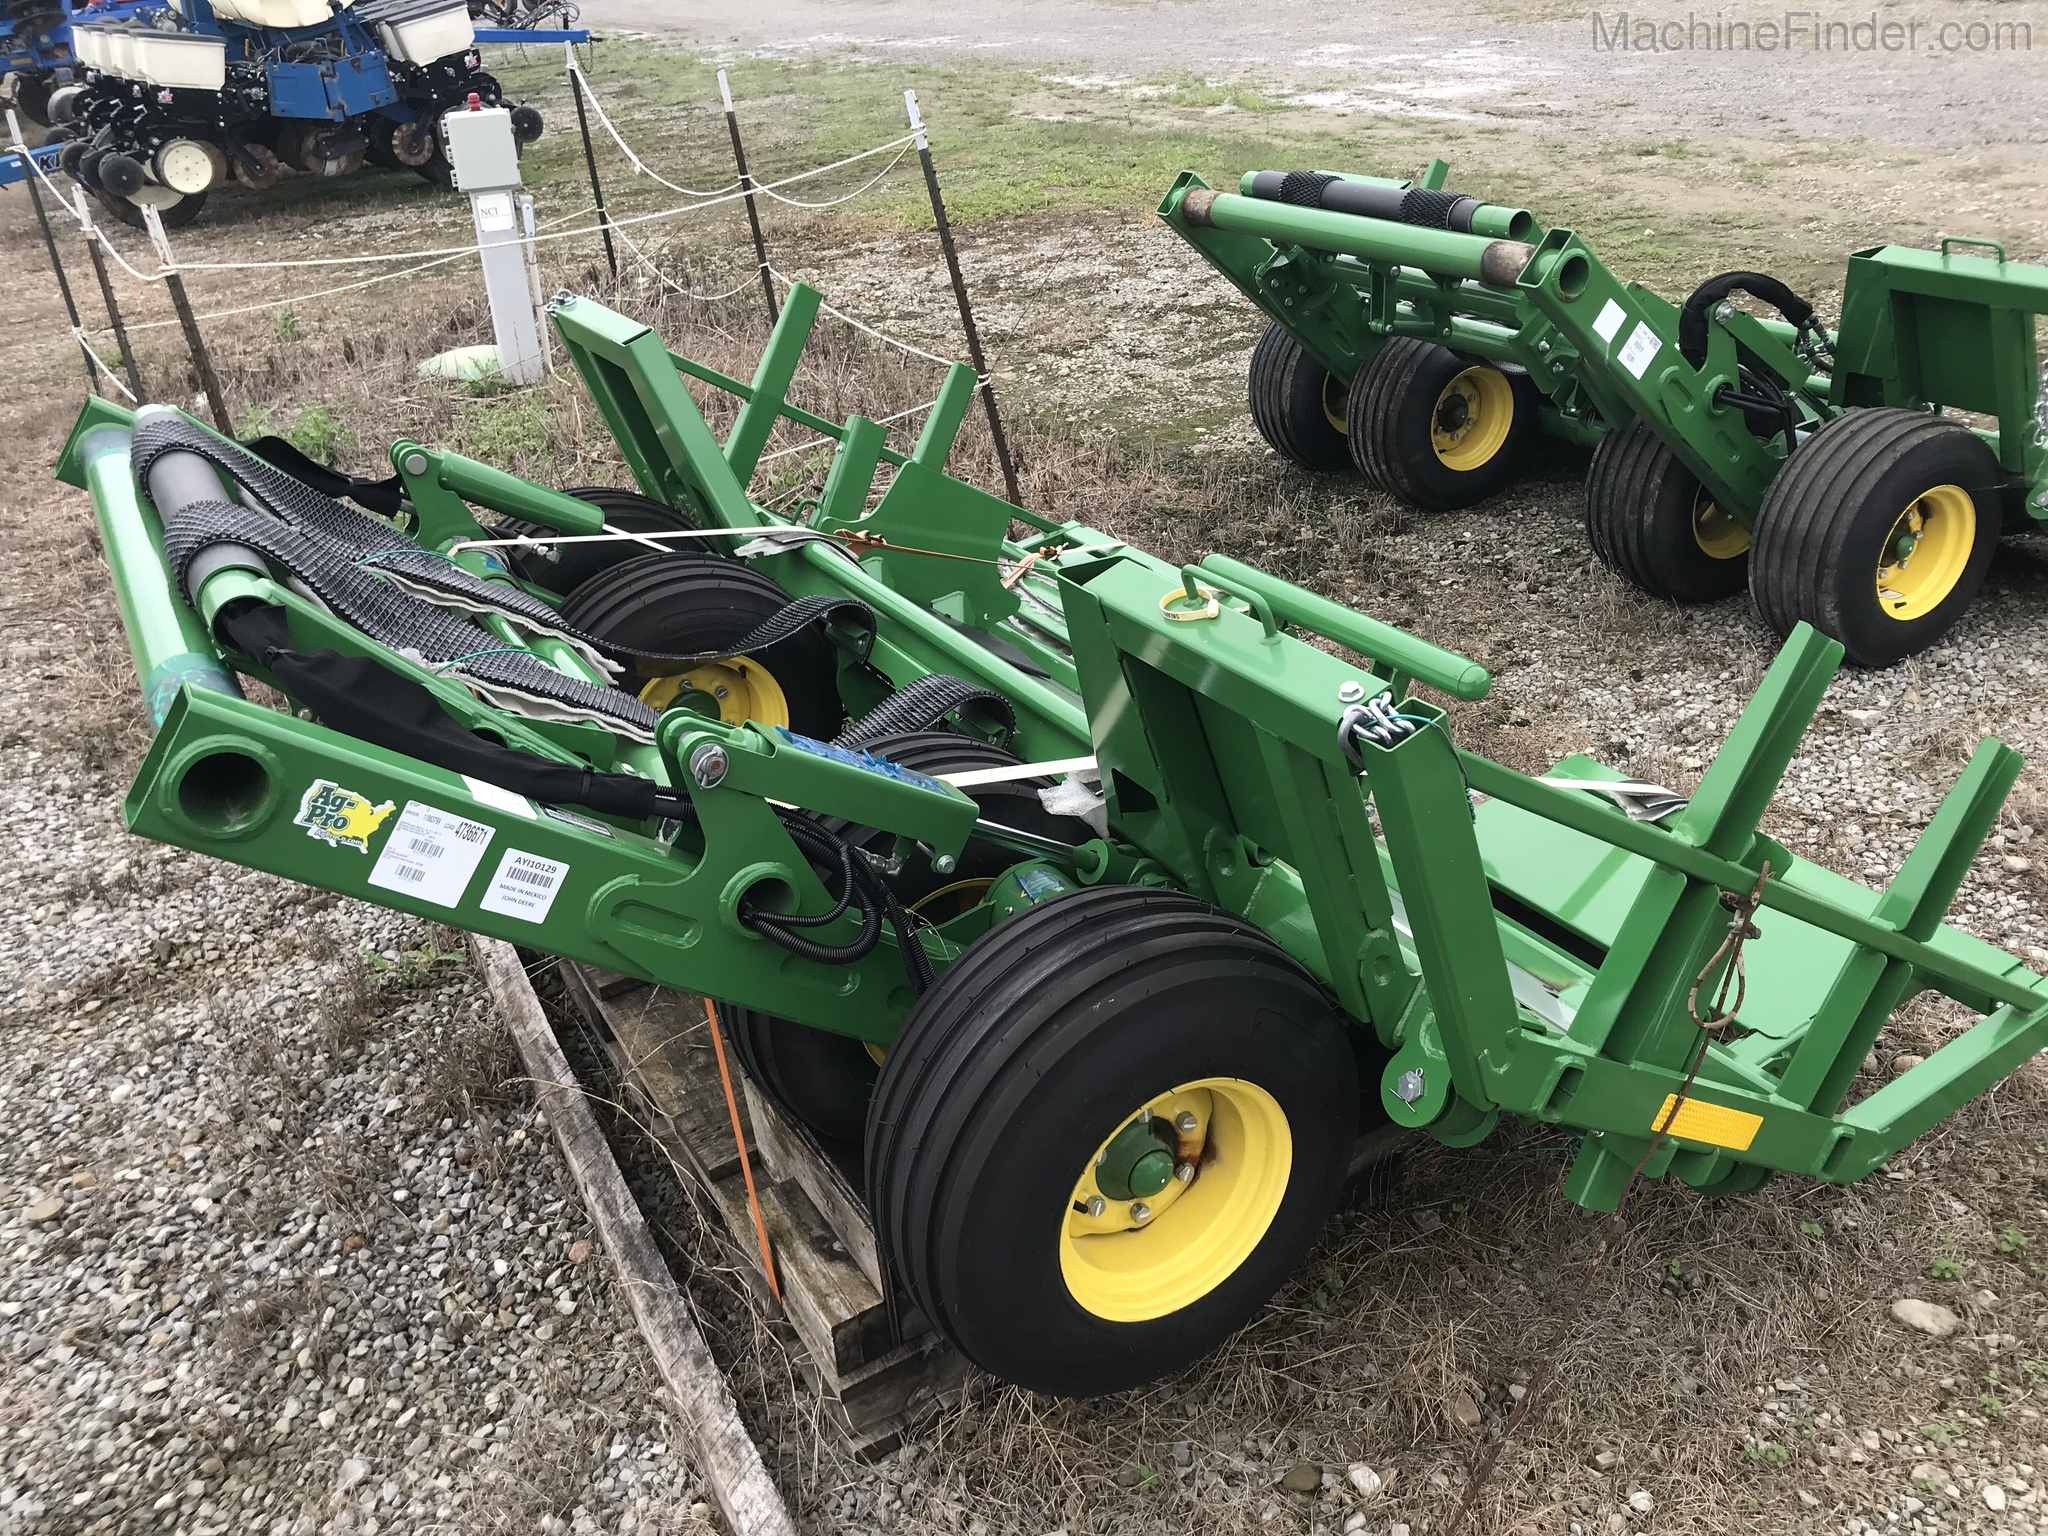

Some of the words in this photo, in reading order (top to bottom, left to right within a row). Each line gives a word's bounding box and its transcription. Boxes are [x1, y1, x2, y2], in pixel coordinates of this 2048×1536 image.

[480, 206, 498, 217] NCI
[310, 784, 357, 813] Ag-
[302, 804, 349, 831] Pro
[315, 828, 363, 847] AgProCo.com
[454, 821, 489, 846] 4736671
[514, 856, 558, 874] AYI10129
[499, 883, 517, 893] MADE
[517, 888, 524, 896] IN
[524, 890, 548, 901] MEXICO
[501, 895, 517, 904] JOHN
[518, 898, 536, 908] DEERE
